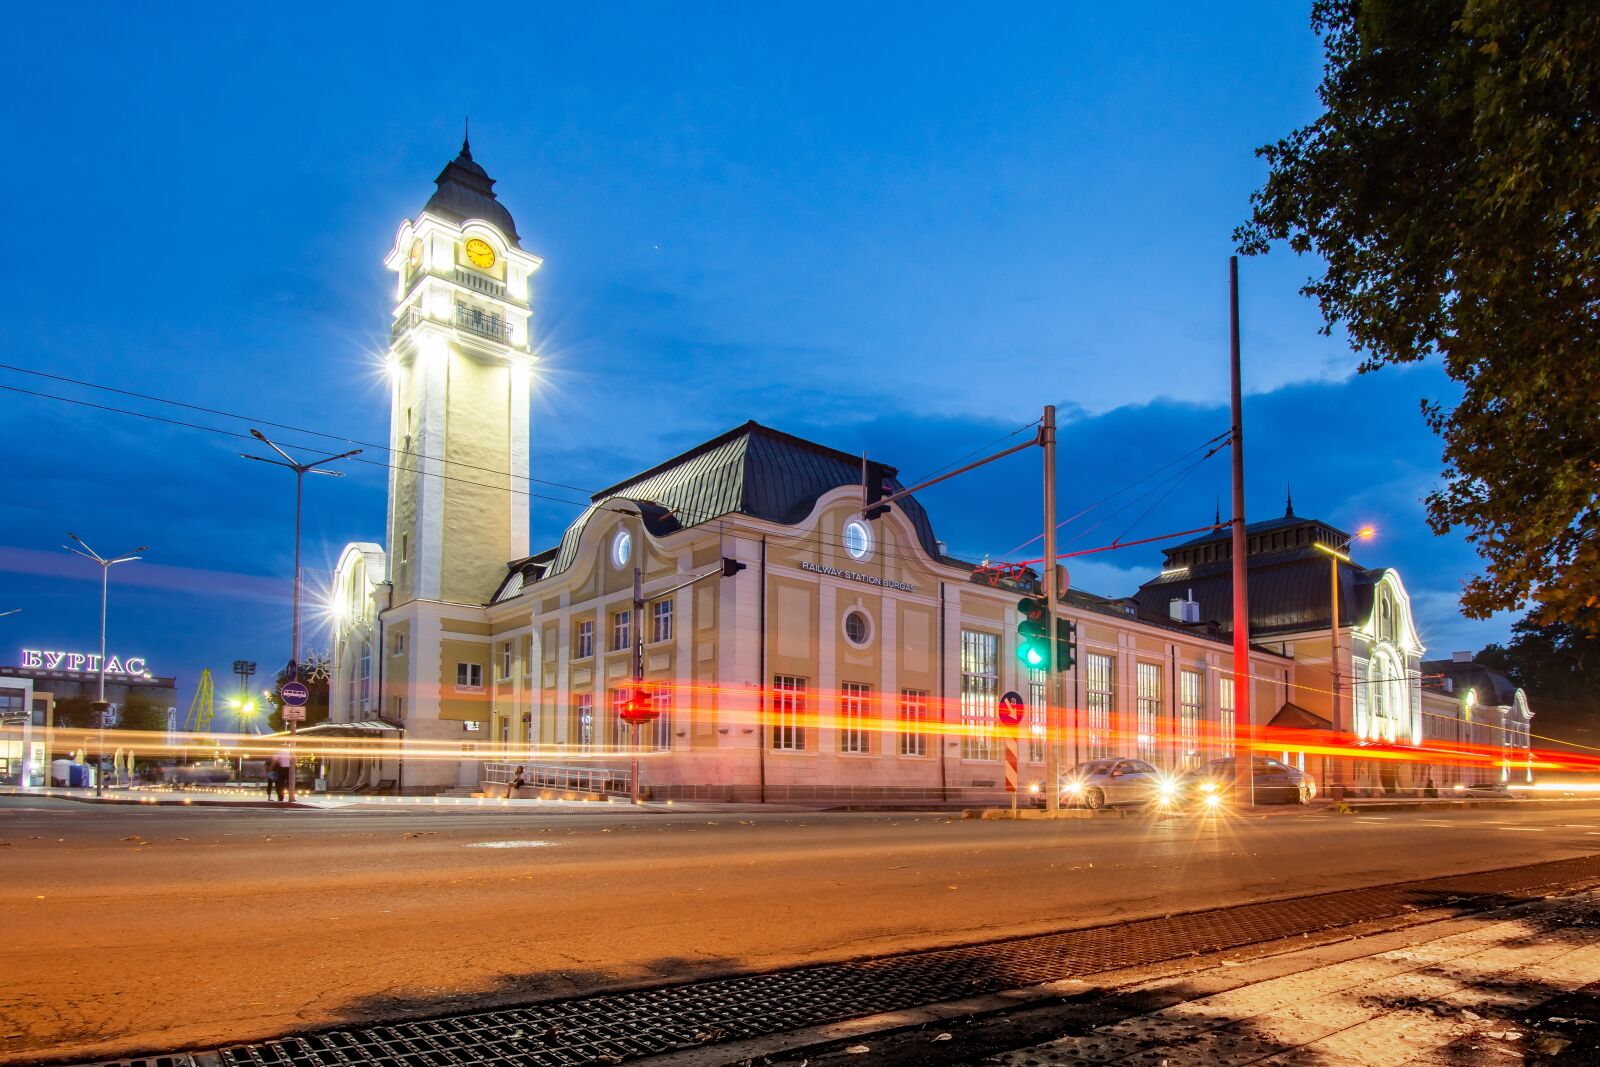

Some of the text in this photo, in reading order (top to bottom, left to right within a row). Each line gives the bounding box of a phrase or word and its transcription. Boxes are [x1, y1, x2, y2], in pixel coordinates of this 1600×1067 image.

[802, 561, 916, 593] RAILWAY STATION BURGAS
[22, 649, 146, 675] БУРГАС
